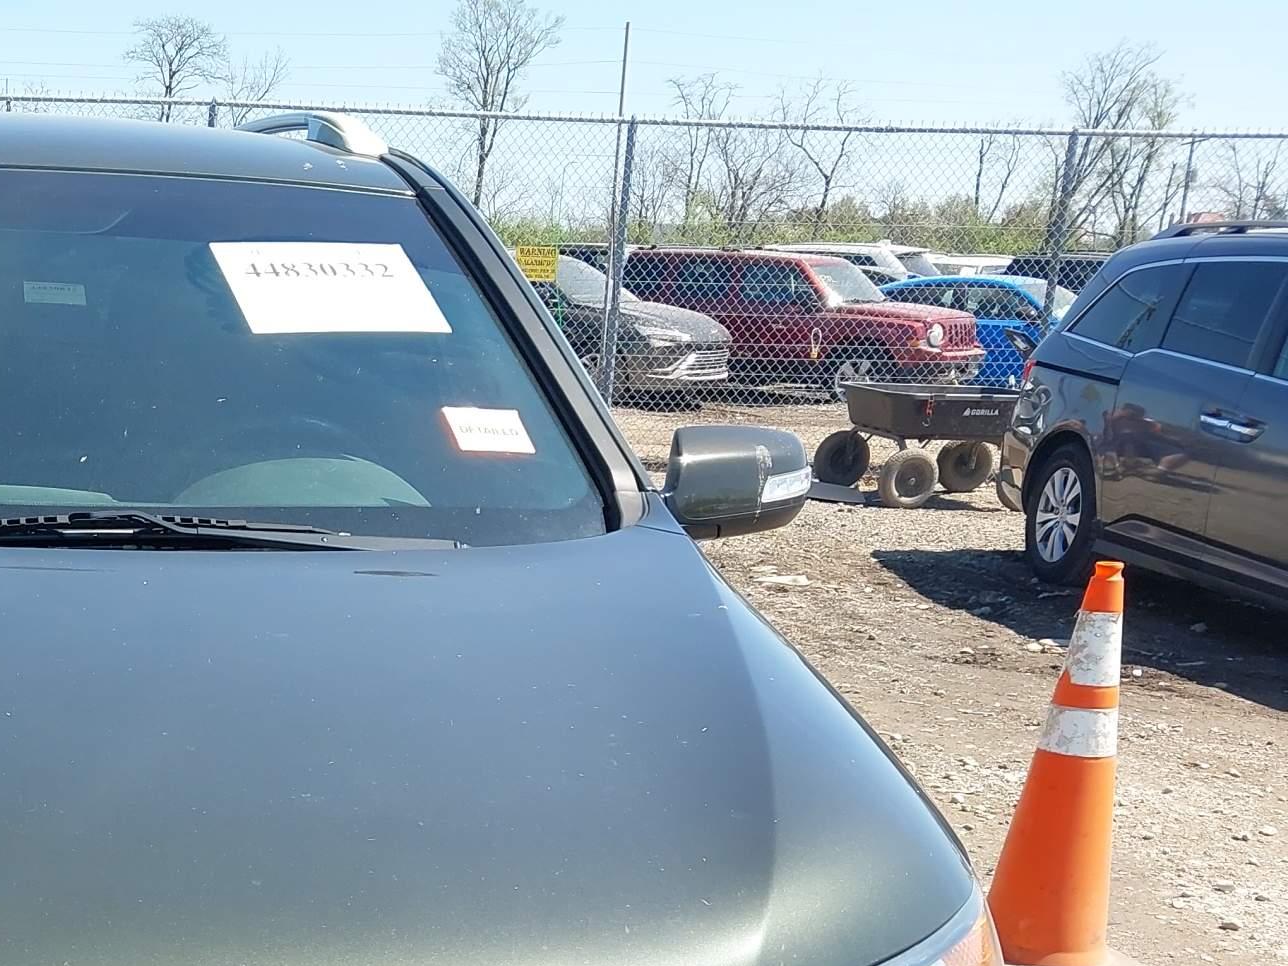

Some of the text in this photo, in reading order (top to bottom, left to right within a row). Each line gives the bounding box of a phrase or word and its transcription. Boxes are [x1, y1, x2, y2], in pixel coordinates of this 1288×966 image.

[519, 248, 556, 257] WARNING
[245, 263, 394, 277] 44830332
[971, 408, 999, 416] GORILLA
